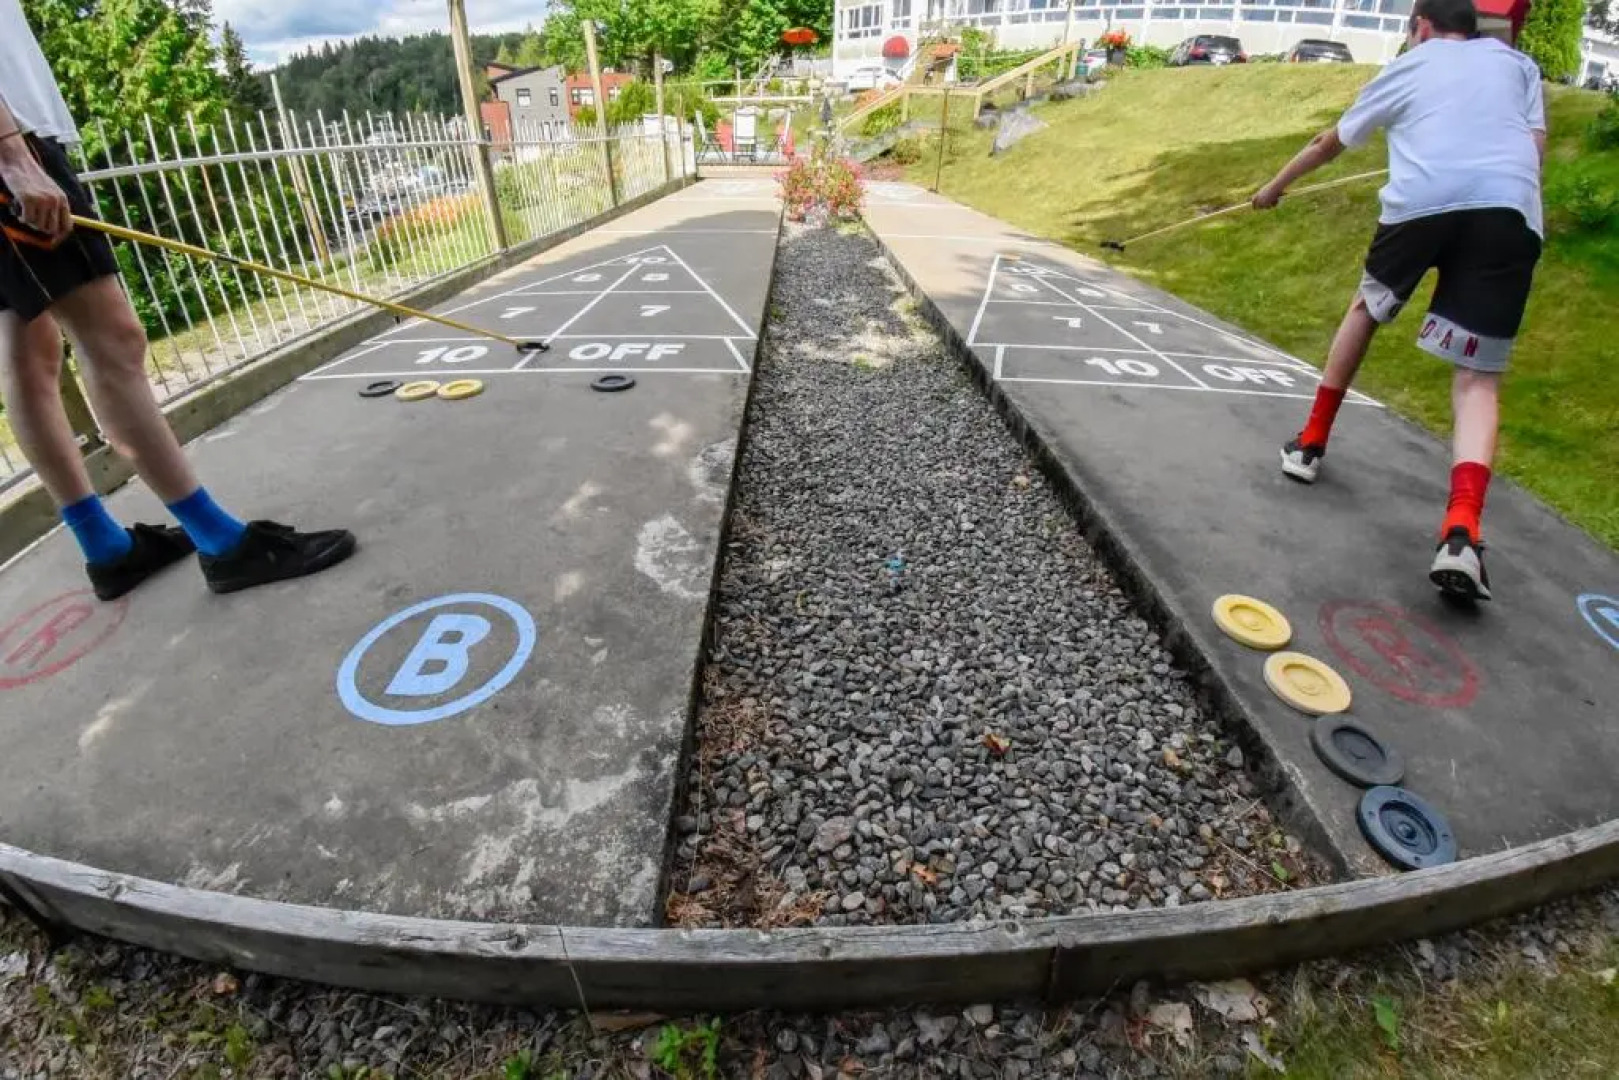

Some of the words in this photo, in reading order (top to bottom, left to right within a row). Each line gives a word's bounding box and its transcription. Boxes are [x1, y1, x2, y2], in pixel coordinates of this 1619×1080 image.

[499, 306, 537, 318] 7
[640, 304, 671, 317] 7
[414, 345, 489, 364] 10
[568, 343, 686, 361] OFF
[1085, 356, 1160, 377] 10
[1202, 364, 1296, 387] OFF
[384, 613, 491, 696] B
